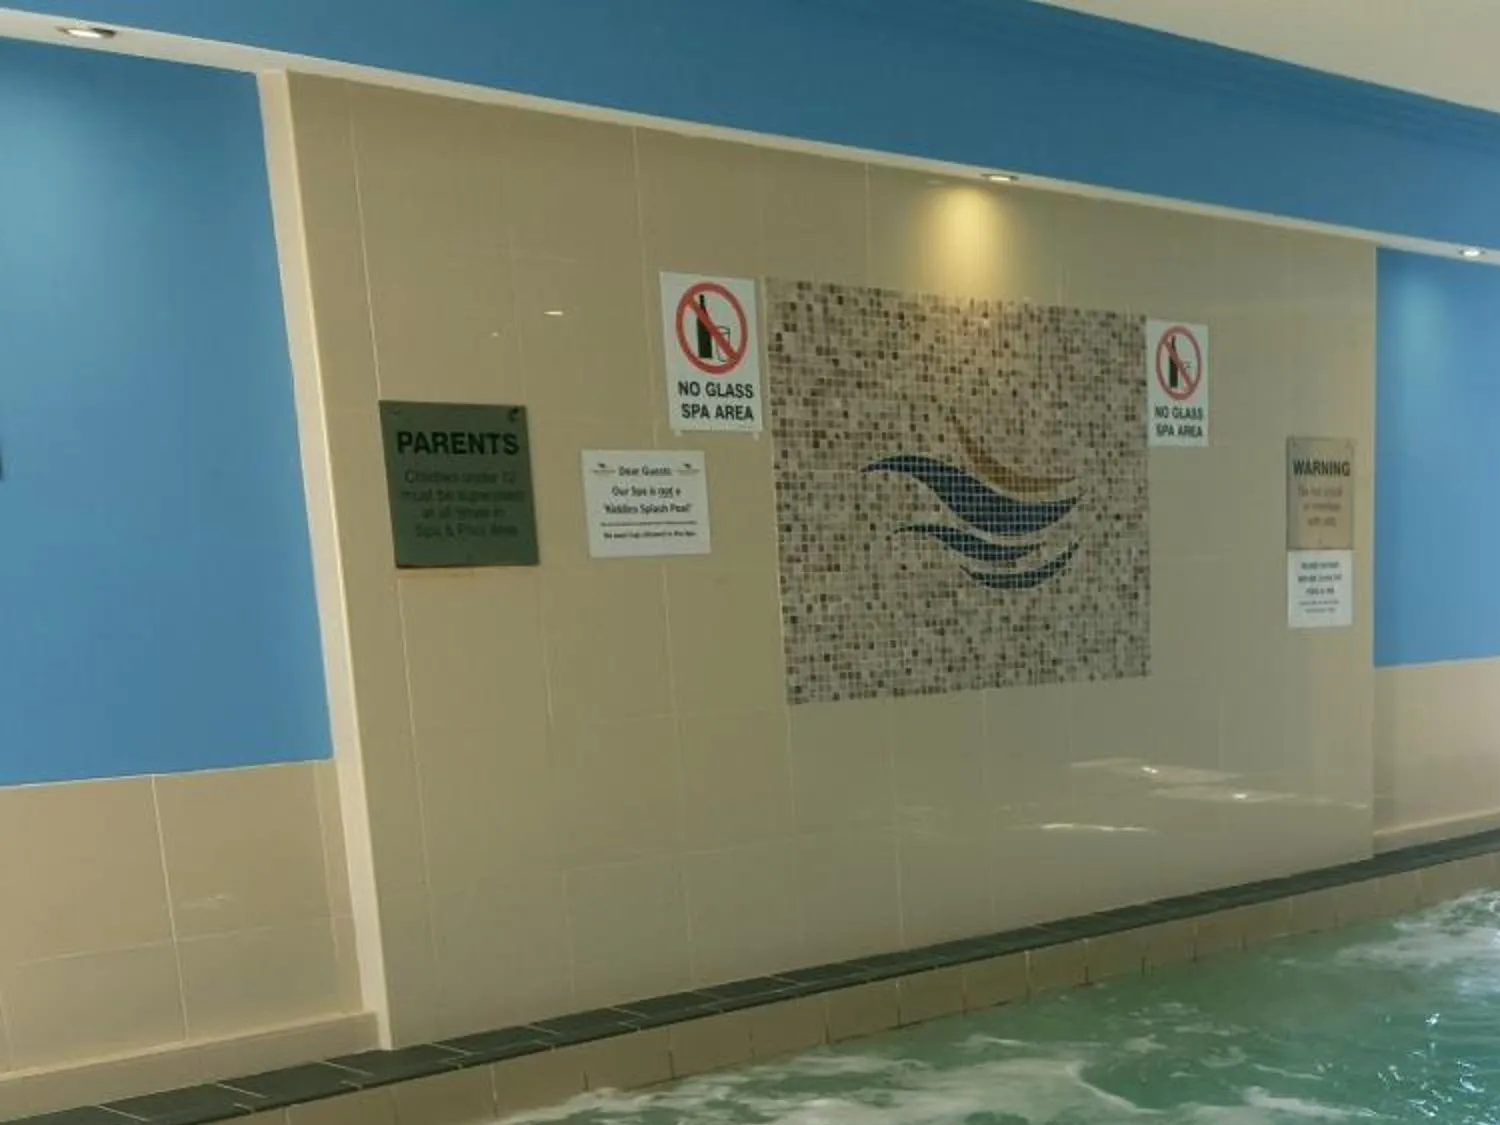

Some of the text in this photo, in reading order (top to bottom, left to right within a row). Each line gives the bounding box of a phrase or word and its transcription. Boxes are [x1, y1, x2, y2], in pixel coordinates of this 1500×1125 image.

[678, 381, 754, 399] NO GLASS
[681, 403, 754, 421] SPA AREA
[1155, 405, 1203, 420] NO GLASS
[1156, 423, 1203, 437] SPA AREA
[397, 431, 520, 456] PARENTS
[618, 466, 639, 477] Dear
[1292, 459, 1351, 476] WARNING
[611, 486, 629, 497] Our
